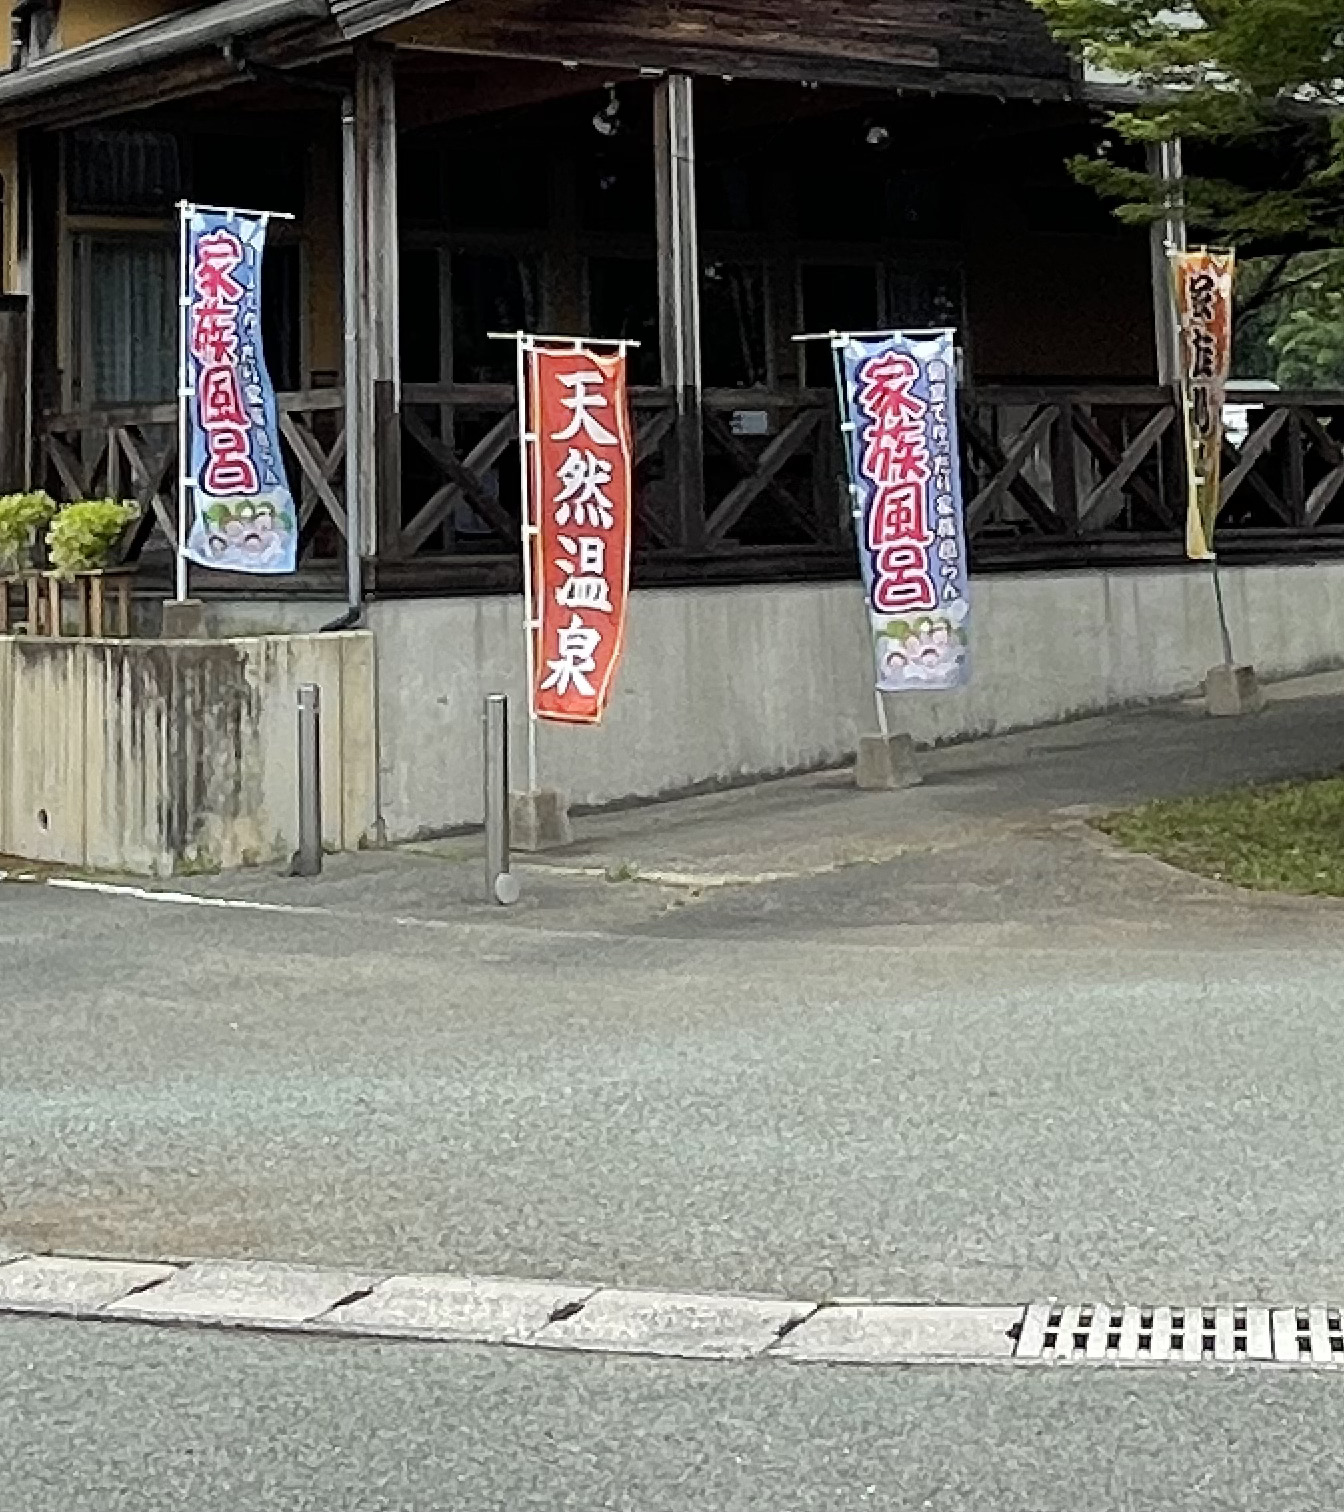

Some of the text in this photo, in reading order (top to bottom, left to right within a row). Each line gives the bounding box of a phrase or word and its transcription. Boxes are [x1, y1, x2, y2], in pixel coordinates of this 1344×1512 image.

[191, 228, 260, 496] 家族風呂
[857, 349, 939, 613] 家族風呂
[541, 370, 619, 696] 天然温泉
